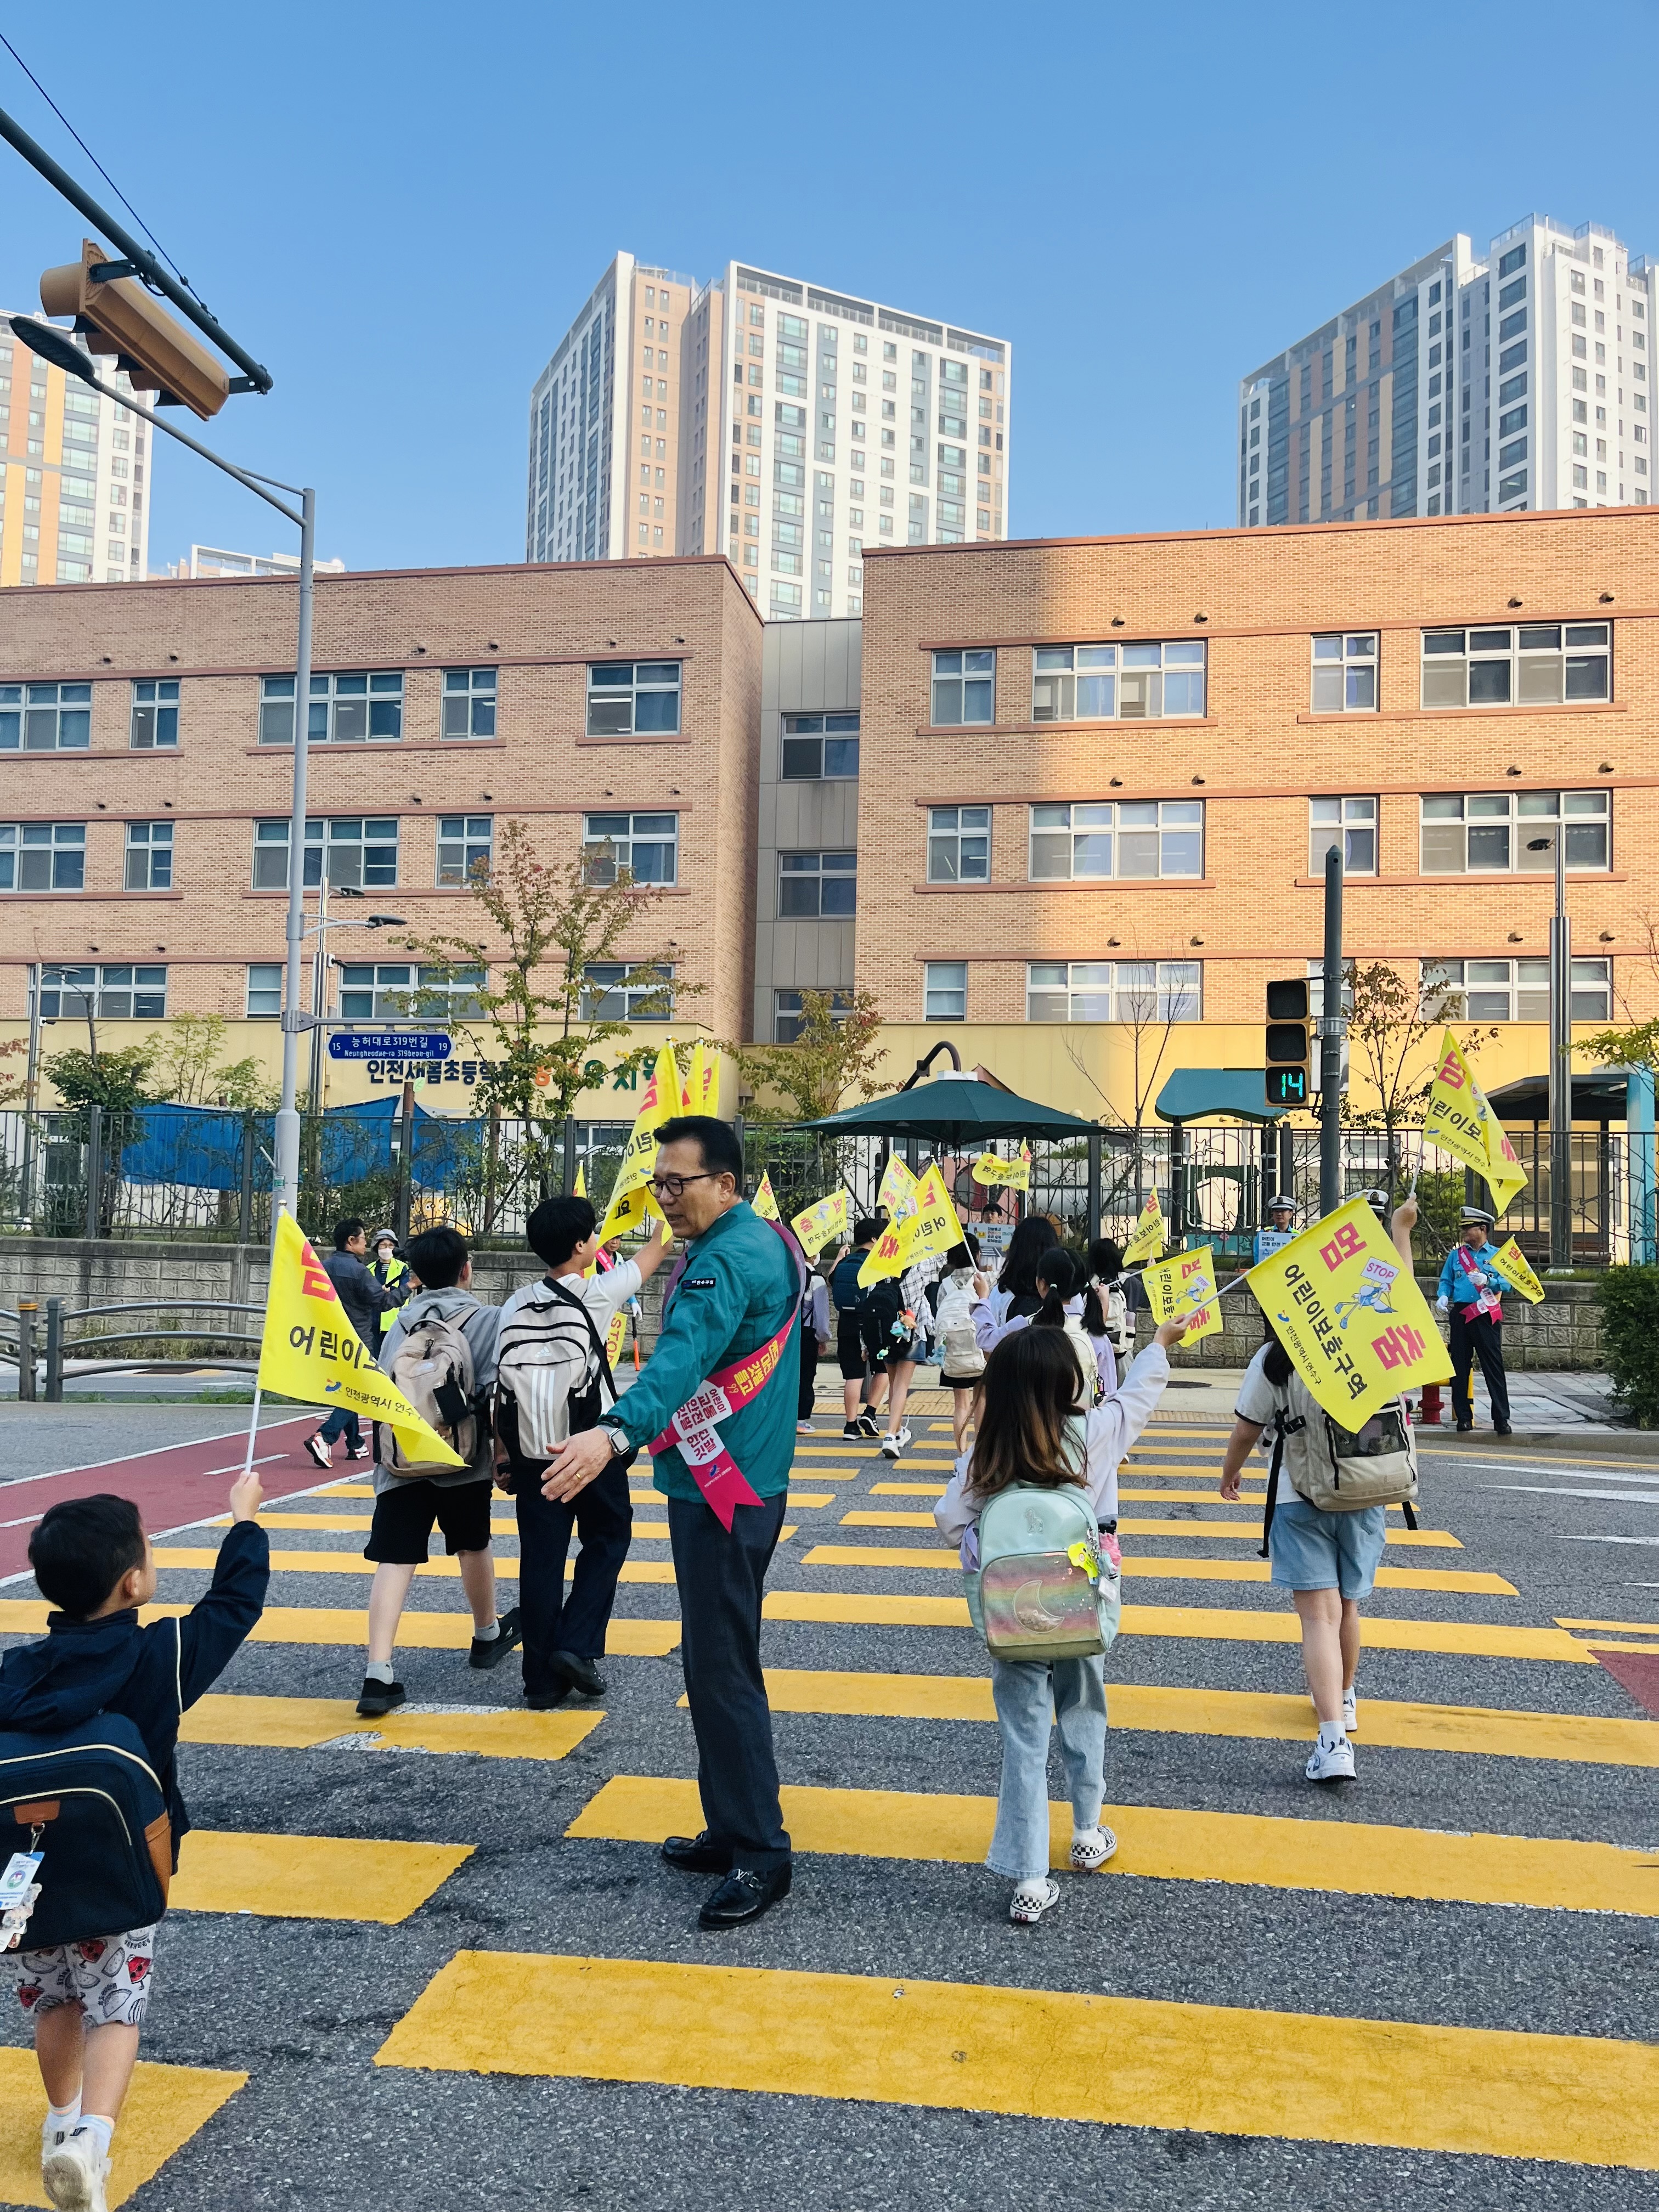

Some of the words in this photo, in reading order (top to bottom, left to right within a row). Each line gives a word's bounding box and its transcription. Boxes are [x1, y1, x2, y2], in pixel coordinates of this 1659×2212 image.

[332, 1042, 341, 1051] 15
[351, 1036, 428, 1048] 능허대로319번길
[397, 1050, 434, 1058] 319beon-gil
[1282, 1073, 1303, 1097] 14
[1430, 1097, 1486, 1148] 린이보
[1366, 1262, 1395, 1279] STOP
[1319, 1221, 1368, 1272] 멈
[1372, 1323, 1426, 1370] 춤
[1284, 1263, 1368, 1400] 어린이보호구역
[1288, 1325, 1309, 1364] 인천광역시
[1306, 1362, 1322, 1385] 연수구
[733, 1369, 754, 1396] 들고
[747, 1361, 765, 1386] 깃발
[346, 1386, 392, 1409] 인천광역시
[395, 1402, 422, 1420] 연수
[686, 1399, 705, 1425] 안전
[697, 1392, 717, 1420] 교통
[709, 1389, 726, 1413] 어린이
[694, 1437, 717, 1460] 깃발
